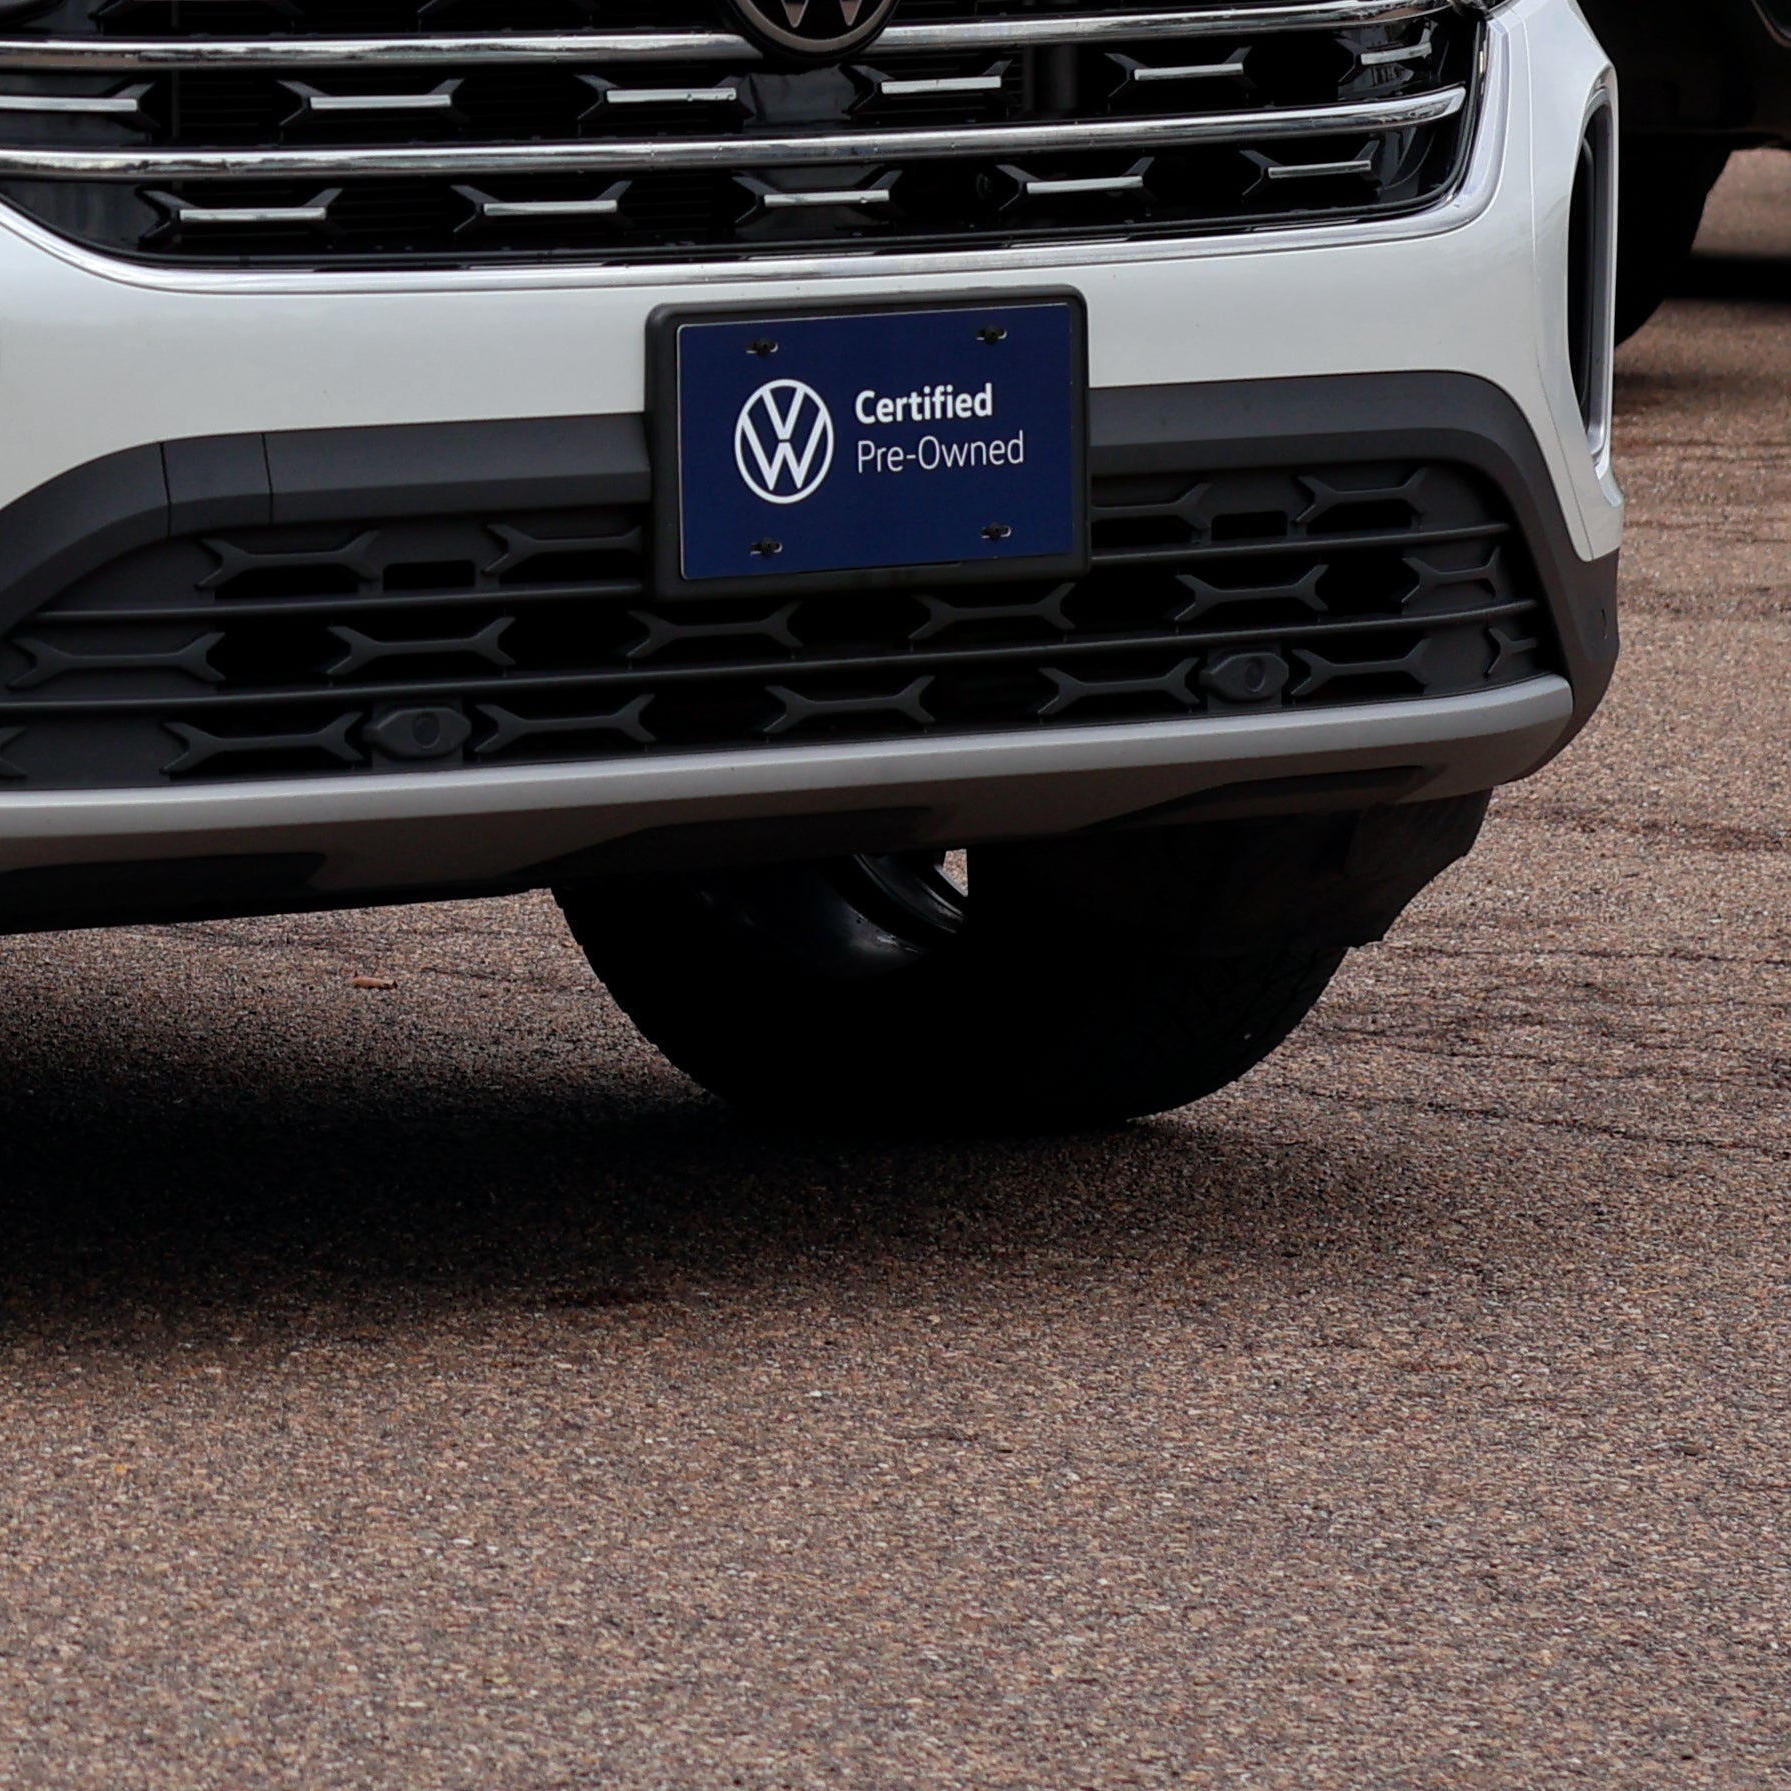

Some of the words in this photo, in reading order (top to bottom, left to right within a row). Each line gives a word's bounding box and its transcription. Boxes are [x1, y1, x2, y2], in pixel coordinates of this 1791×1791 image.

[854, 382, 993, 425] Certified
[736, 380, 832, 502] VW
[857, 429, 1025, 474] Pre-Owned
